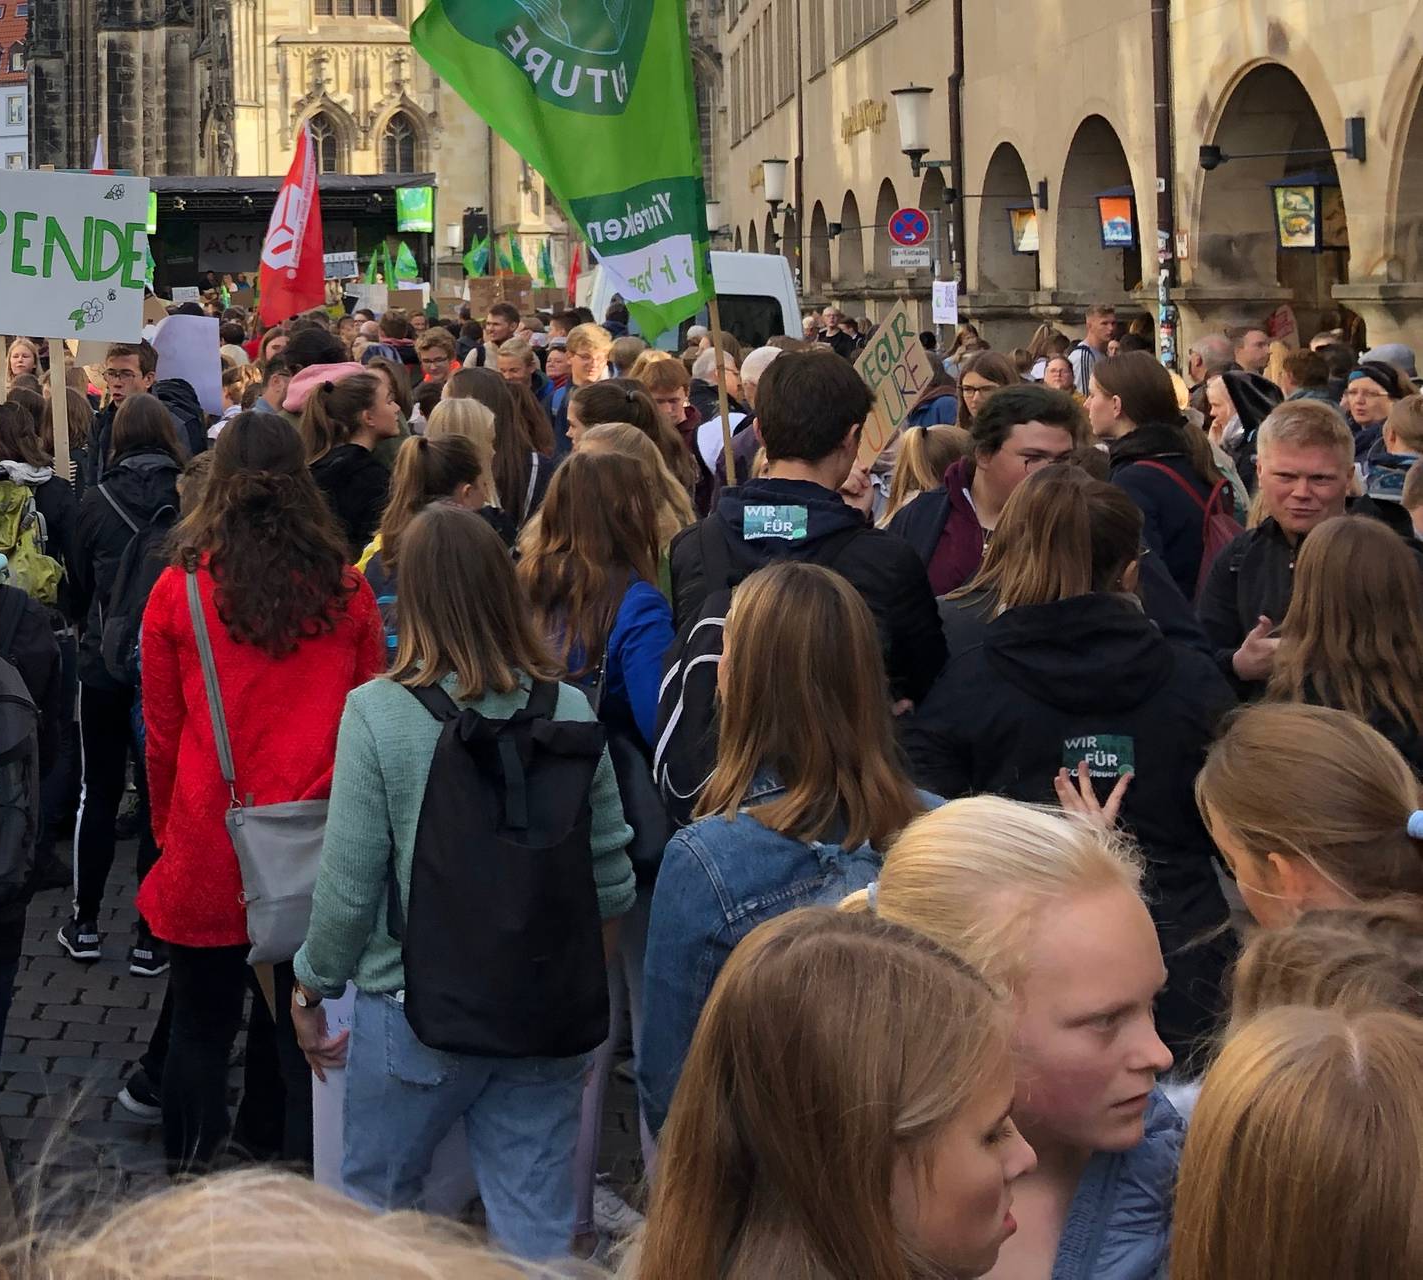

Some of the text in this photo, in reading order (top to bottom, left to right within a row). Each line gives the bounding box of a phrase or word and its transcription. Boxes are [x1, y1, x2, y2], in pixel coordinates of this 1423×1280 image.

[744, 505, 776, 517] WIR
[763, 519, 793, 532] FÜR
[1064, 736, 1097, 749] WIR
[1085, 750, 1118, 767] FÜR
